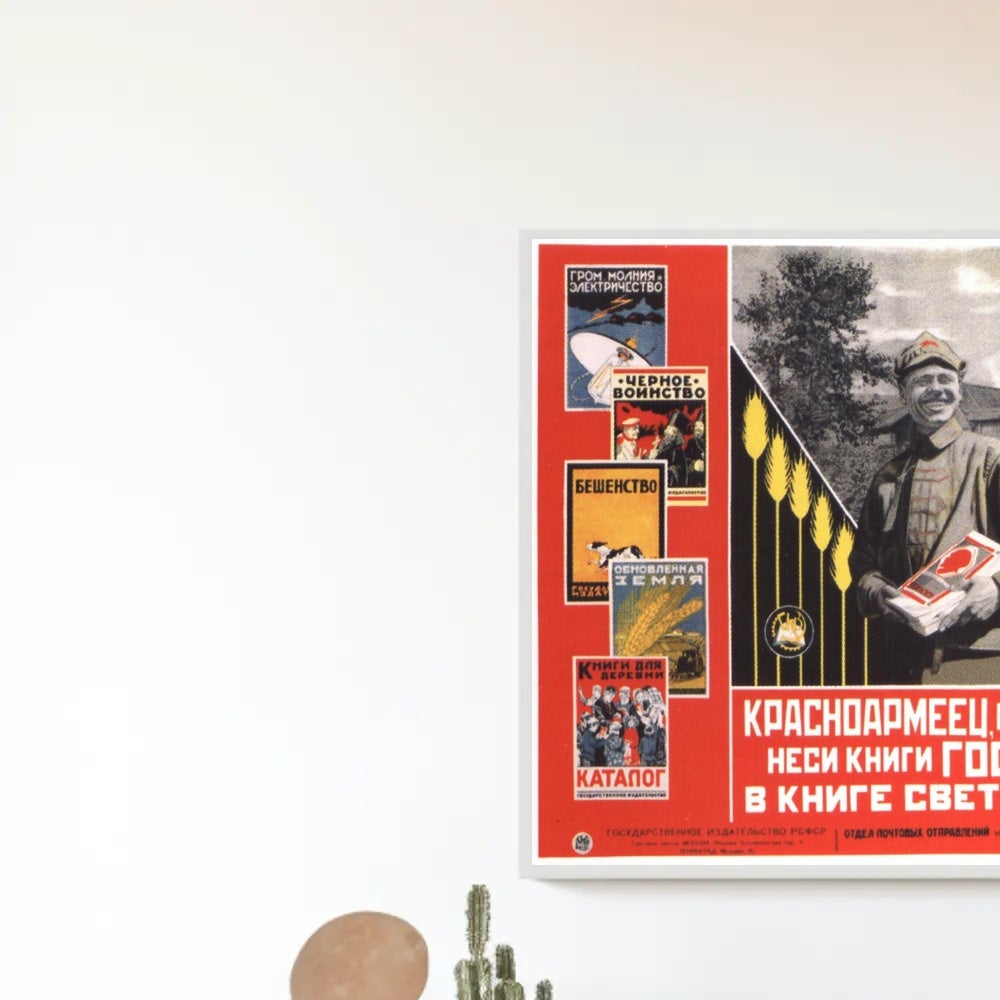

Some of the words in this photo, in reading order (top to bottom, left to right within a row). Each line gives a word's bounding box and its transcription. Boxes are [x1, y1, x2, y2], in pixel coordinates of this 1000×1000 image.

[608, 270, 655, 281] МОЛНИЯ
[569, 281, 663, 293] ЭЛЕКТРИЧЕСТВО
[613, 387, 706, 399] ВОИНСТВО
[575, 479, 658, 494] БЕШЕНСТВО
[614, 564, 704, 575] ОБНОВЛЕННАЯ
[614, 575, 703, 586] ЗЕМЛЯ
[601, 671, 664, 680] ДЕРЕВНИ
[744, 698, 993, 739] КРАСНОАРМЕЕЦ,
[767, 747, 838, 774] НЕСИ
[846, 746, 933, 773] КНИГИ
[577, 769, 666, 787] КАТАЛОГ
[745, 785, 766, 813] В
[778, 784, 892, 812] КНИГЕ
[904, 783, 999, 811] СВЕТ
[844, 829, 873, 839] ОТДЕЛ
